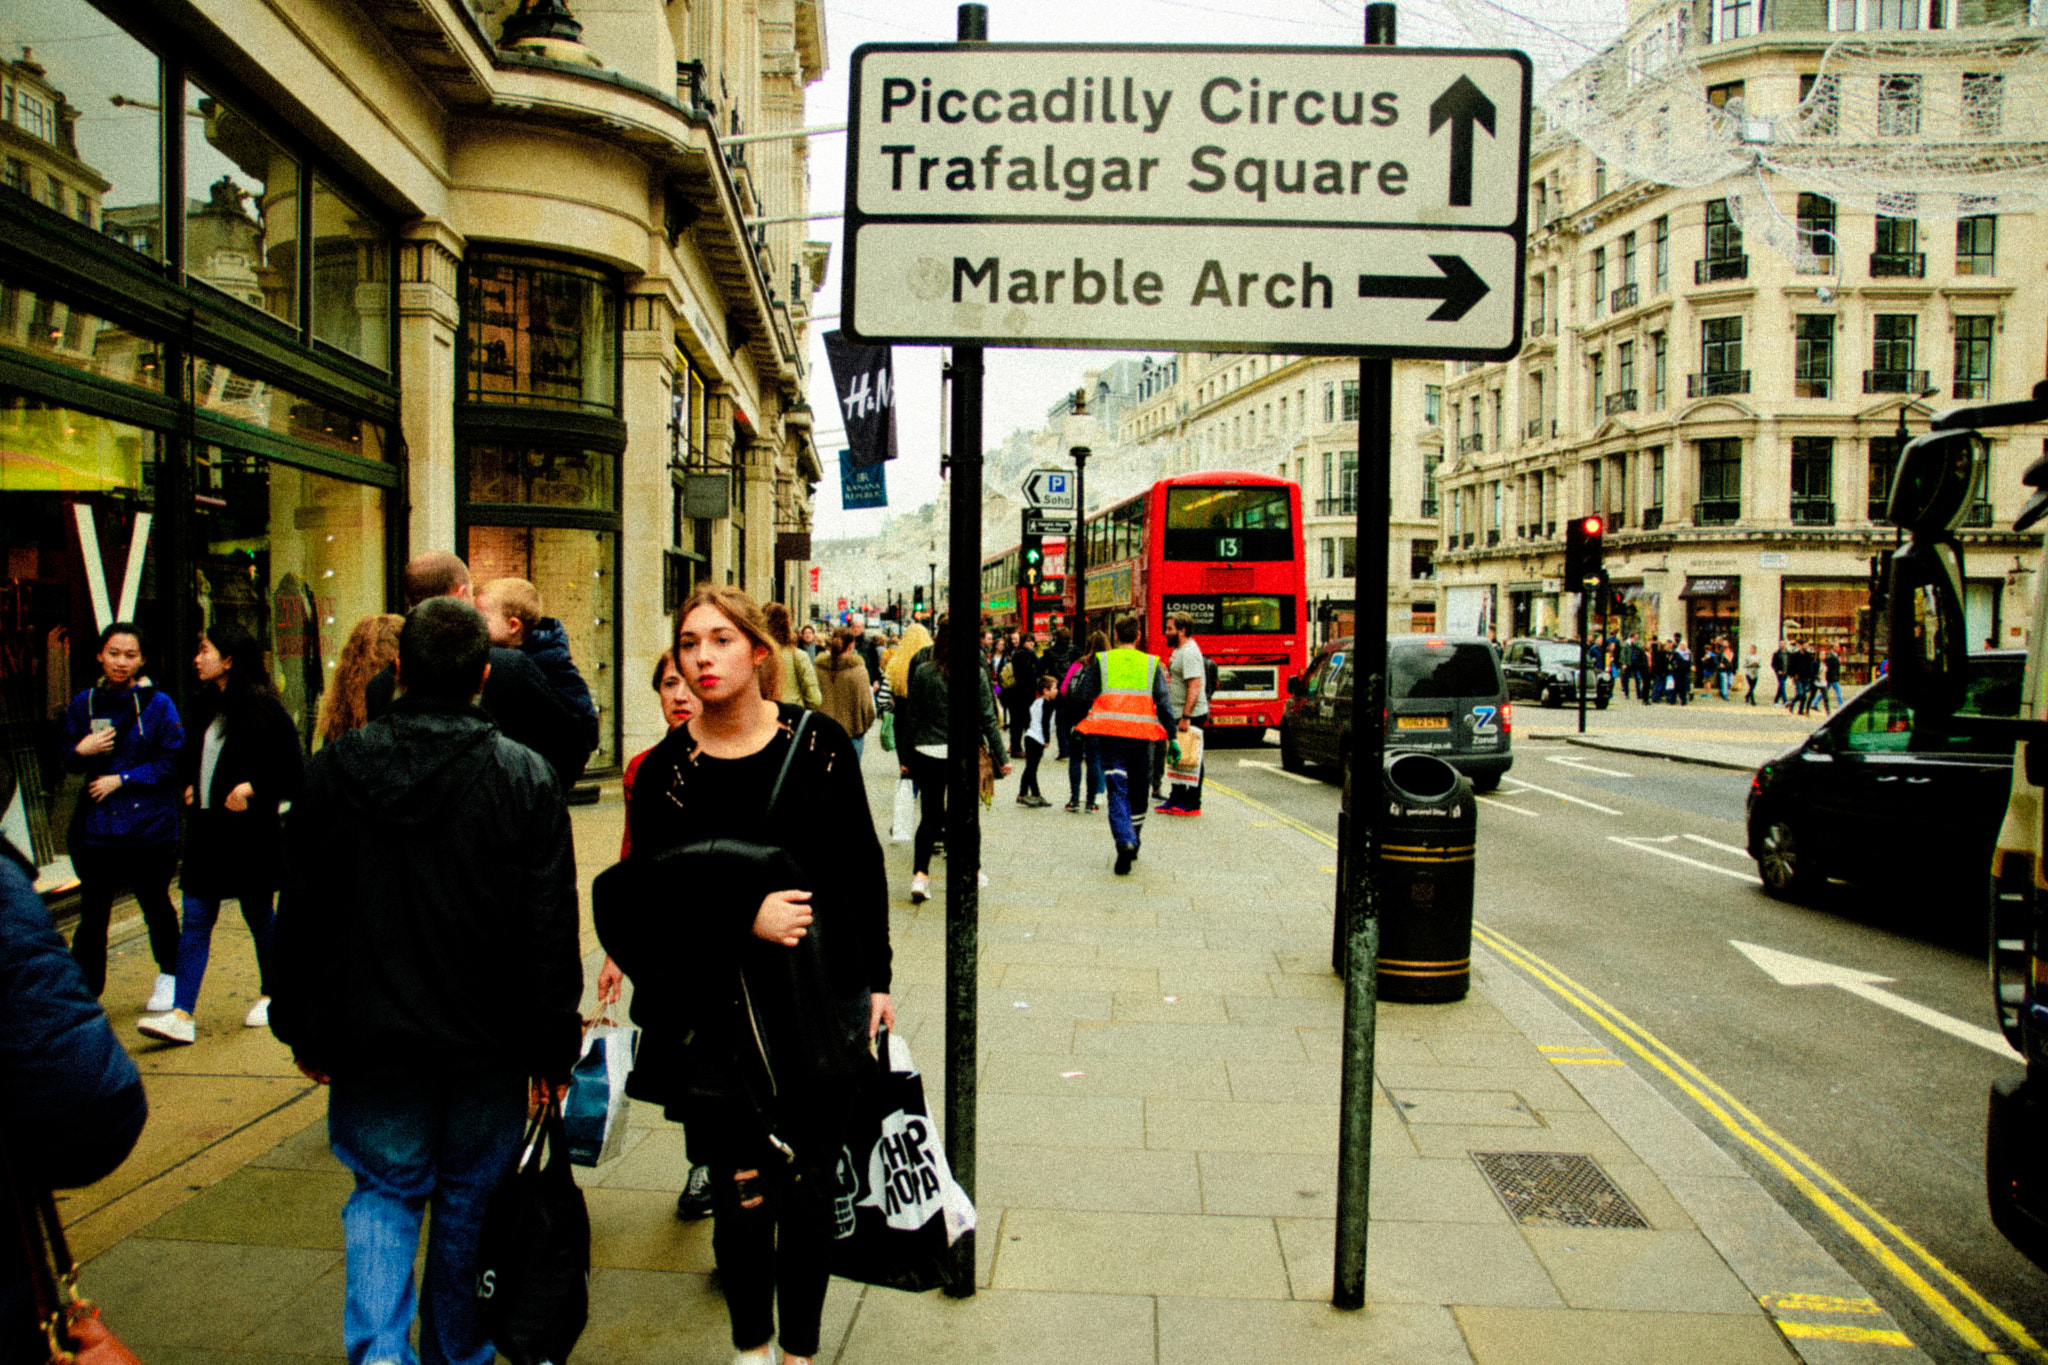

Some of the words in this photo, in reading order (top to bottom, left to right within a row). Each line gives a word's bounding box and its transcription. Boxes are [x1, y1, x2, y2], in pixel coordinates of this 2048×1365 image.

[881, 77, 1172, 133] Piccadilly
[1201, 78, 1398, 126] Circus
[881, 145, 1158, 199] Trafalgar
[1188, 146, 1408, 201] Square
[953, 257, 1163, 304] Marble
[1191, 260, 1332, 309] Arch
[1044, 494, 1070, 505] Soho
[1219, 538, 1238, 556] 13
[1167, 602, 1215, 612] LONDON
